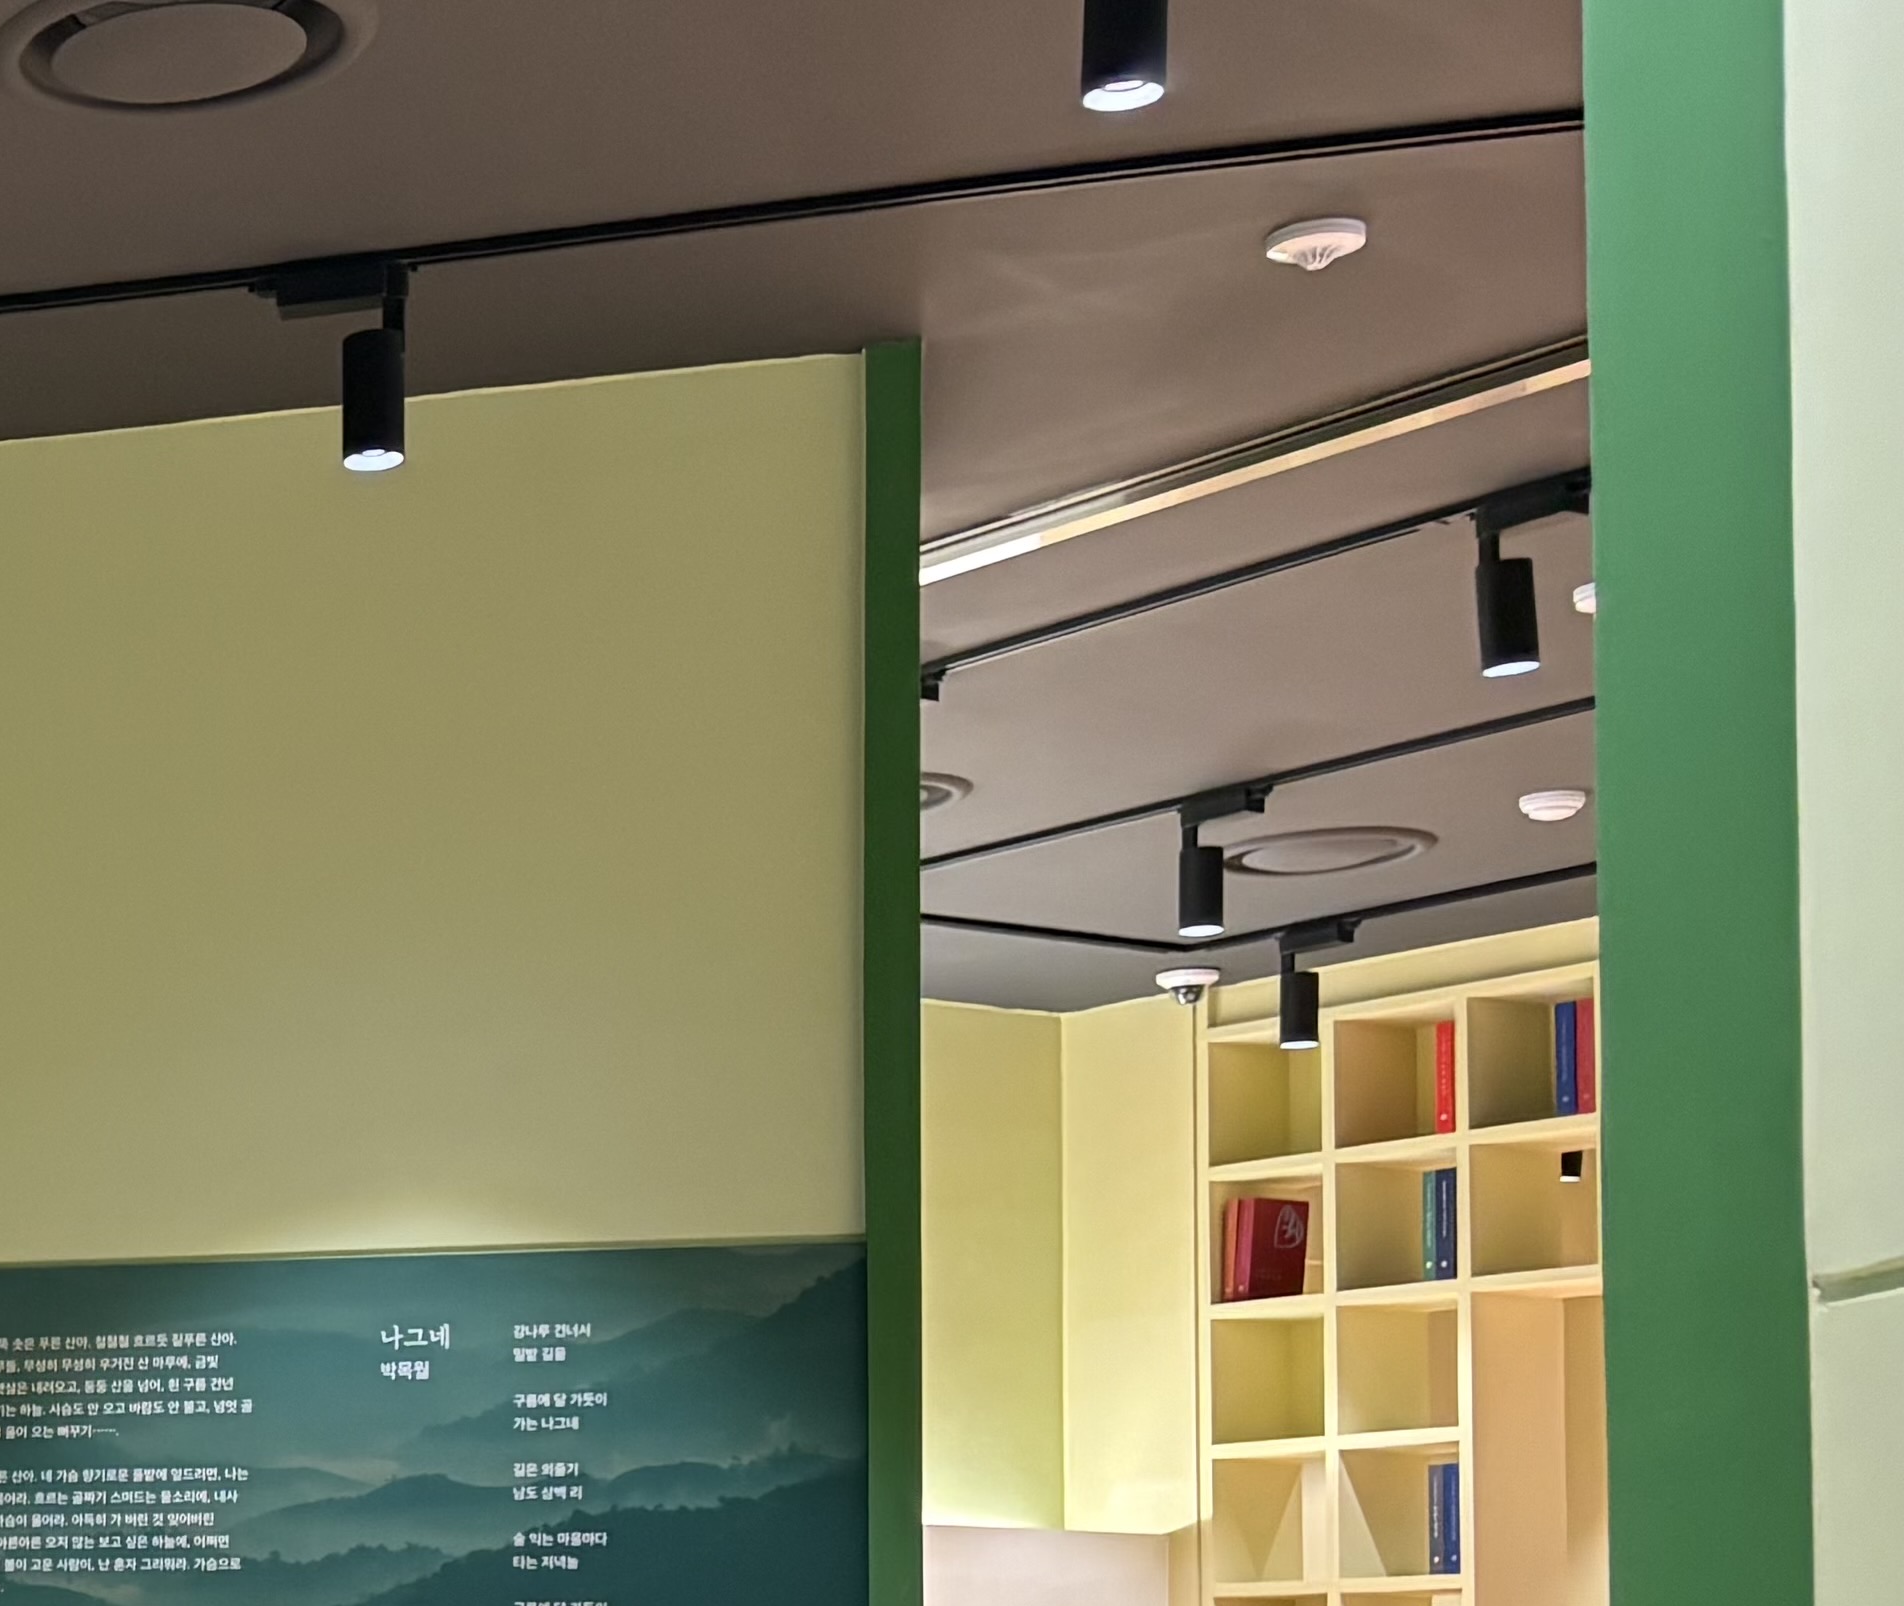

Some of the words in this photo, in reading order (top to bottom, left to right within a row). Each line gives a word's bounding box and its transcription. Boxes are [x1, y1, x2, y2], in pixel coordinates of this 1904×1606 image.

[380, 1323, 449, 1349] 나그네
[380, 1360, 429, 1380] 박목월
[541, 1416, 579, 1430] 나그네
